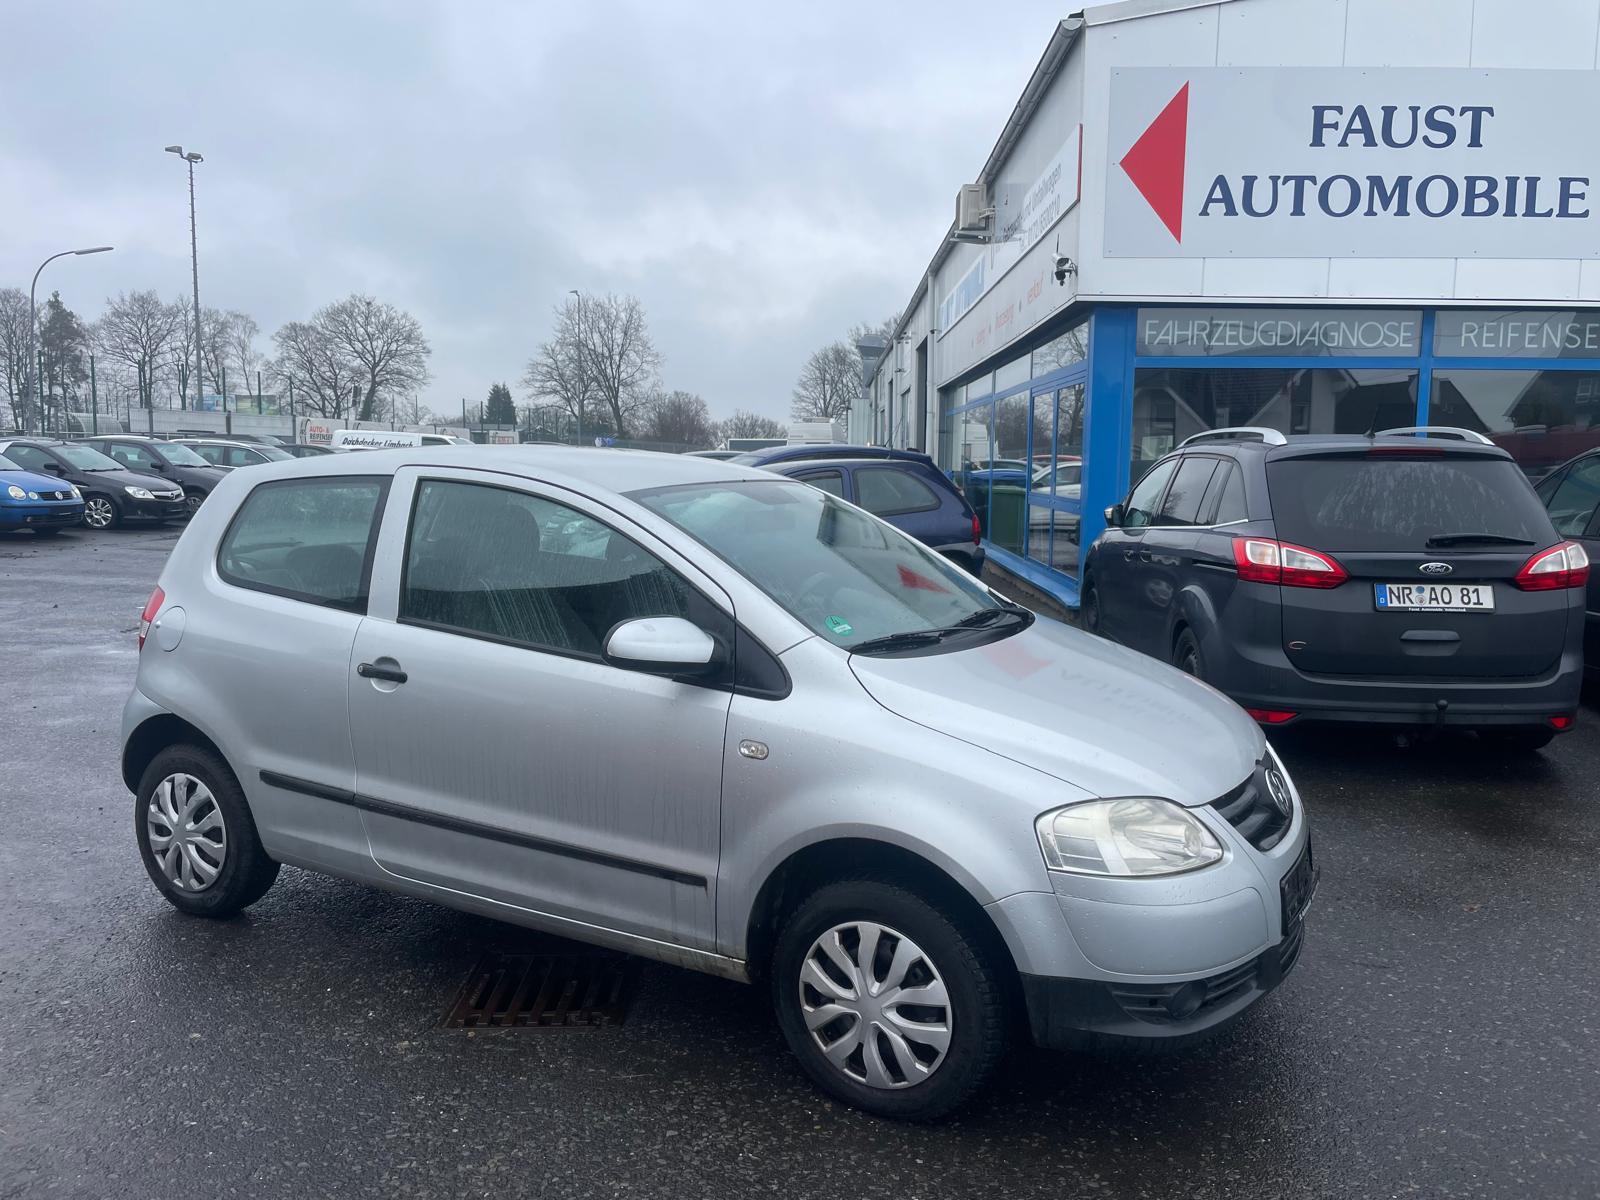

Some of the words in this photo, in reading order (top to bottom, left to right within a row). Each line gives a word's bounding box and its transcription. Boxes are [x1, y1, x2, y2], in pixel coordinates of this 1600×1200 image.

[1309, 104, 1494, 149] FAUST
[1198, 174, 1590, 219] AUTOMOBILE
[1144, 320, 1415, 347] FAHRZEUGDIAGNOSE
[342, 437, 383, 447] Dachdecker
[1426, 563, 1446, 573] Ford
[1388, 586, 1414, 604] NR
[1428, 586, 1452, 605] AO
[1460, 587, 1483, 606] 81
